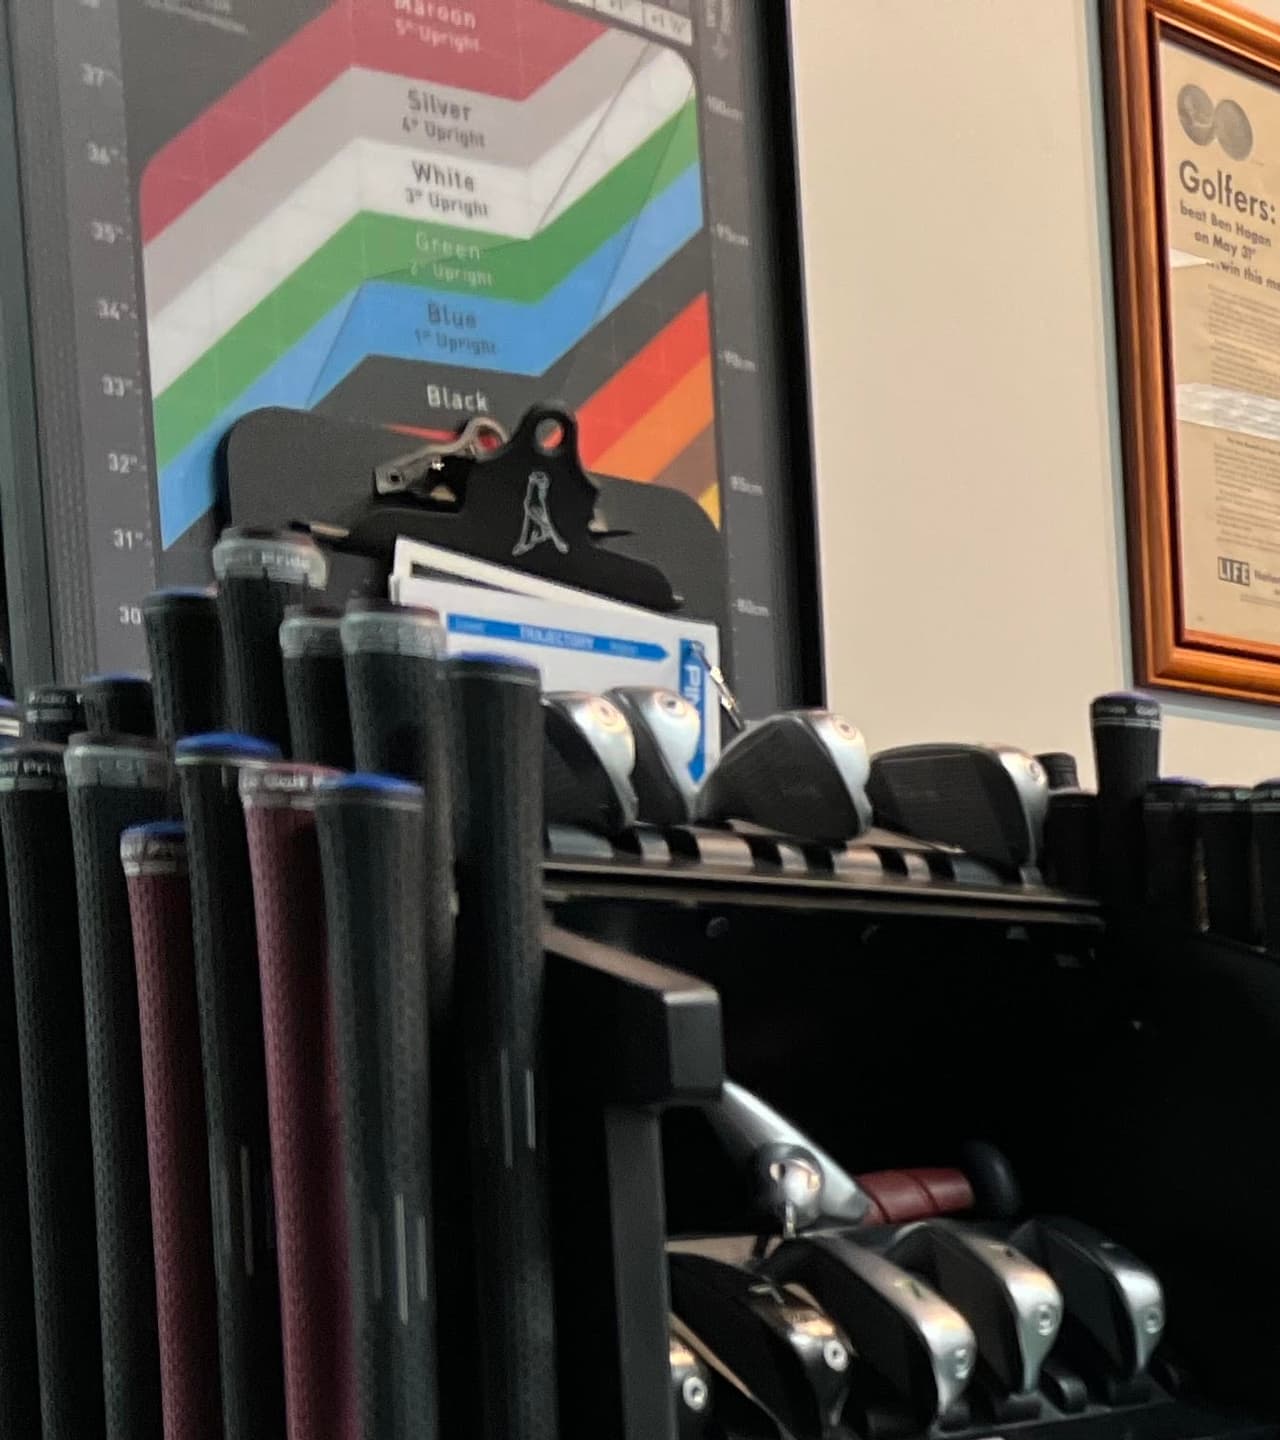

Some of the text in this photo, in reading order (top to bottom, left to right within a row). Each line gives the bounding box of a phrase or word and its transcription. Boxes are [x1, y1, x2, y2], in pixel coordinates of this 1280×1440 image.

[418, 22, 480, 53] Upright
[407, 89, 472, 121] Silver
[424, 120, 486, 149] Upright
[411, 160, 476, 192] White
[428, 192, 489, 218] Upright
[1178, 159, 1276, 225] Golfers:
[1180, 199, 1272, 247] beat Ben Hogan
[416, 230, 480, 260] Green
[1194, 231, 1209, 244] on
[1212, 233, 1238, 257] May
[432, 262, 494, 288] Upright
[1243, 267, 1264, 285] this
[427, 302, 478, 330] Blue
[435, 331, 497, 356] Upright
[426, 383, 488, 413] Black
[1219, 558, 1250, 586] LIFE
